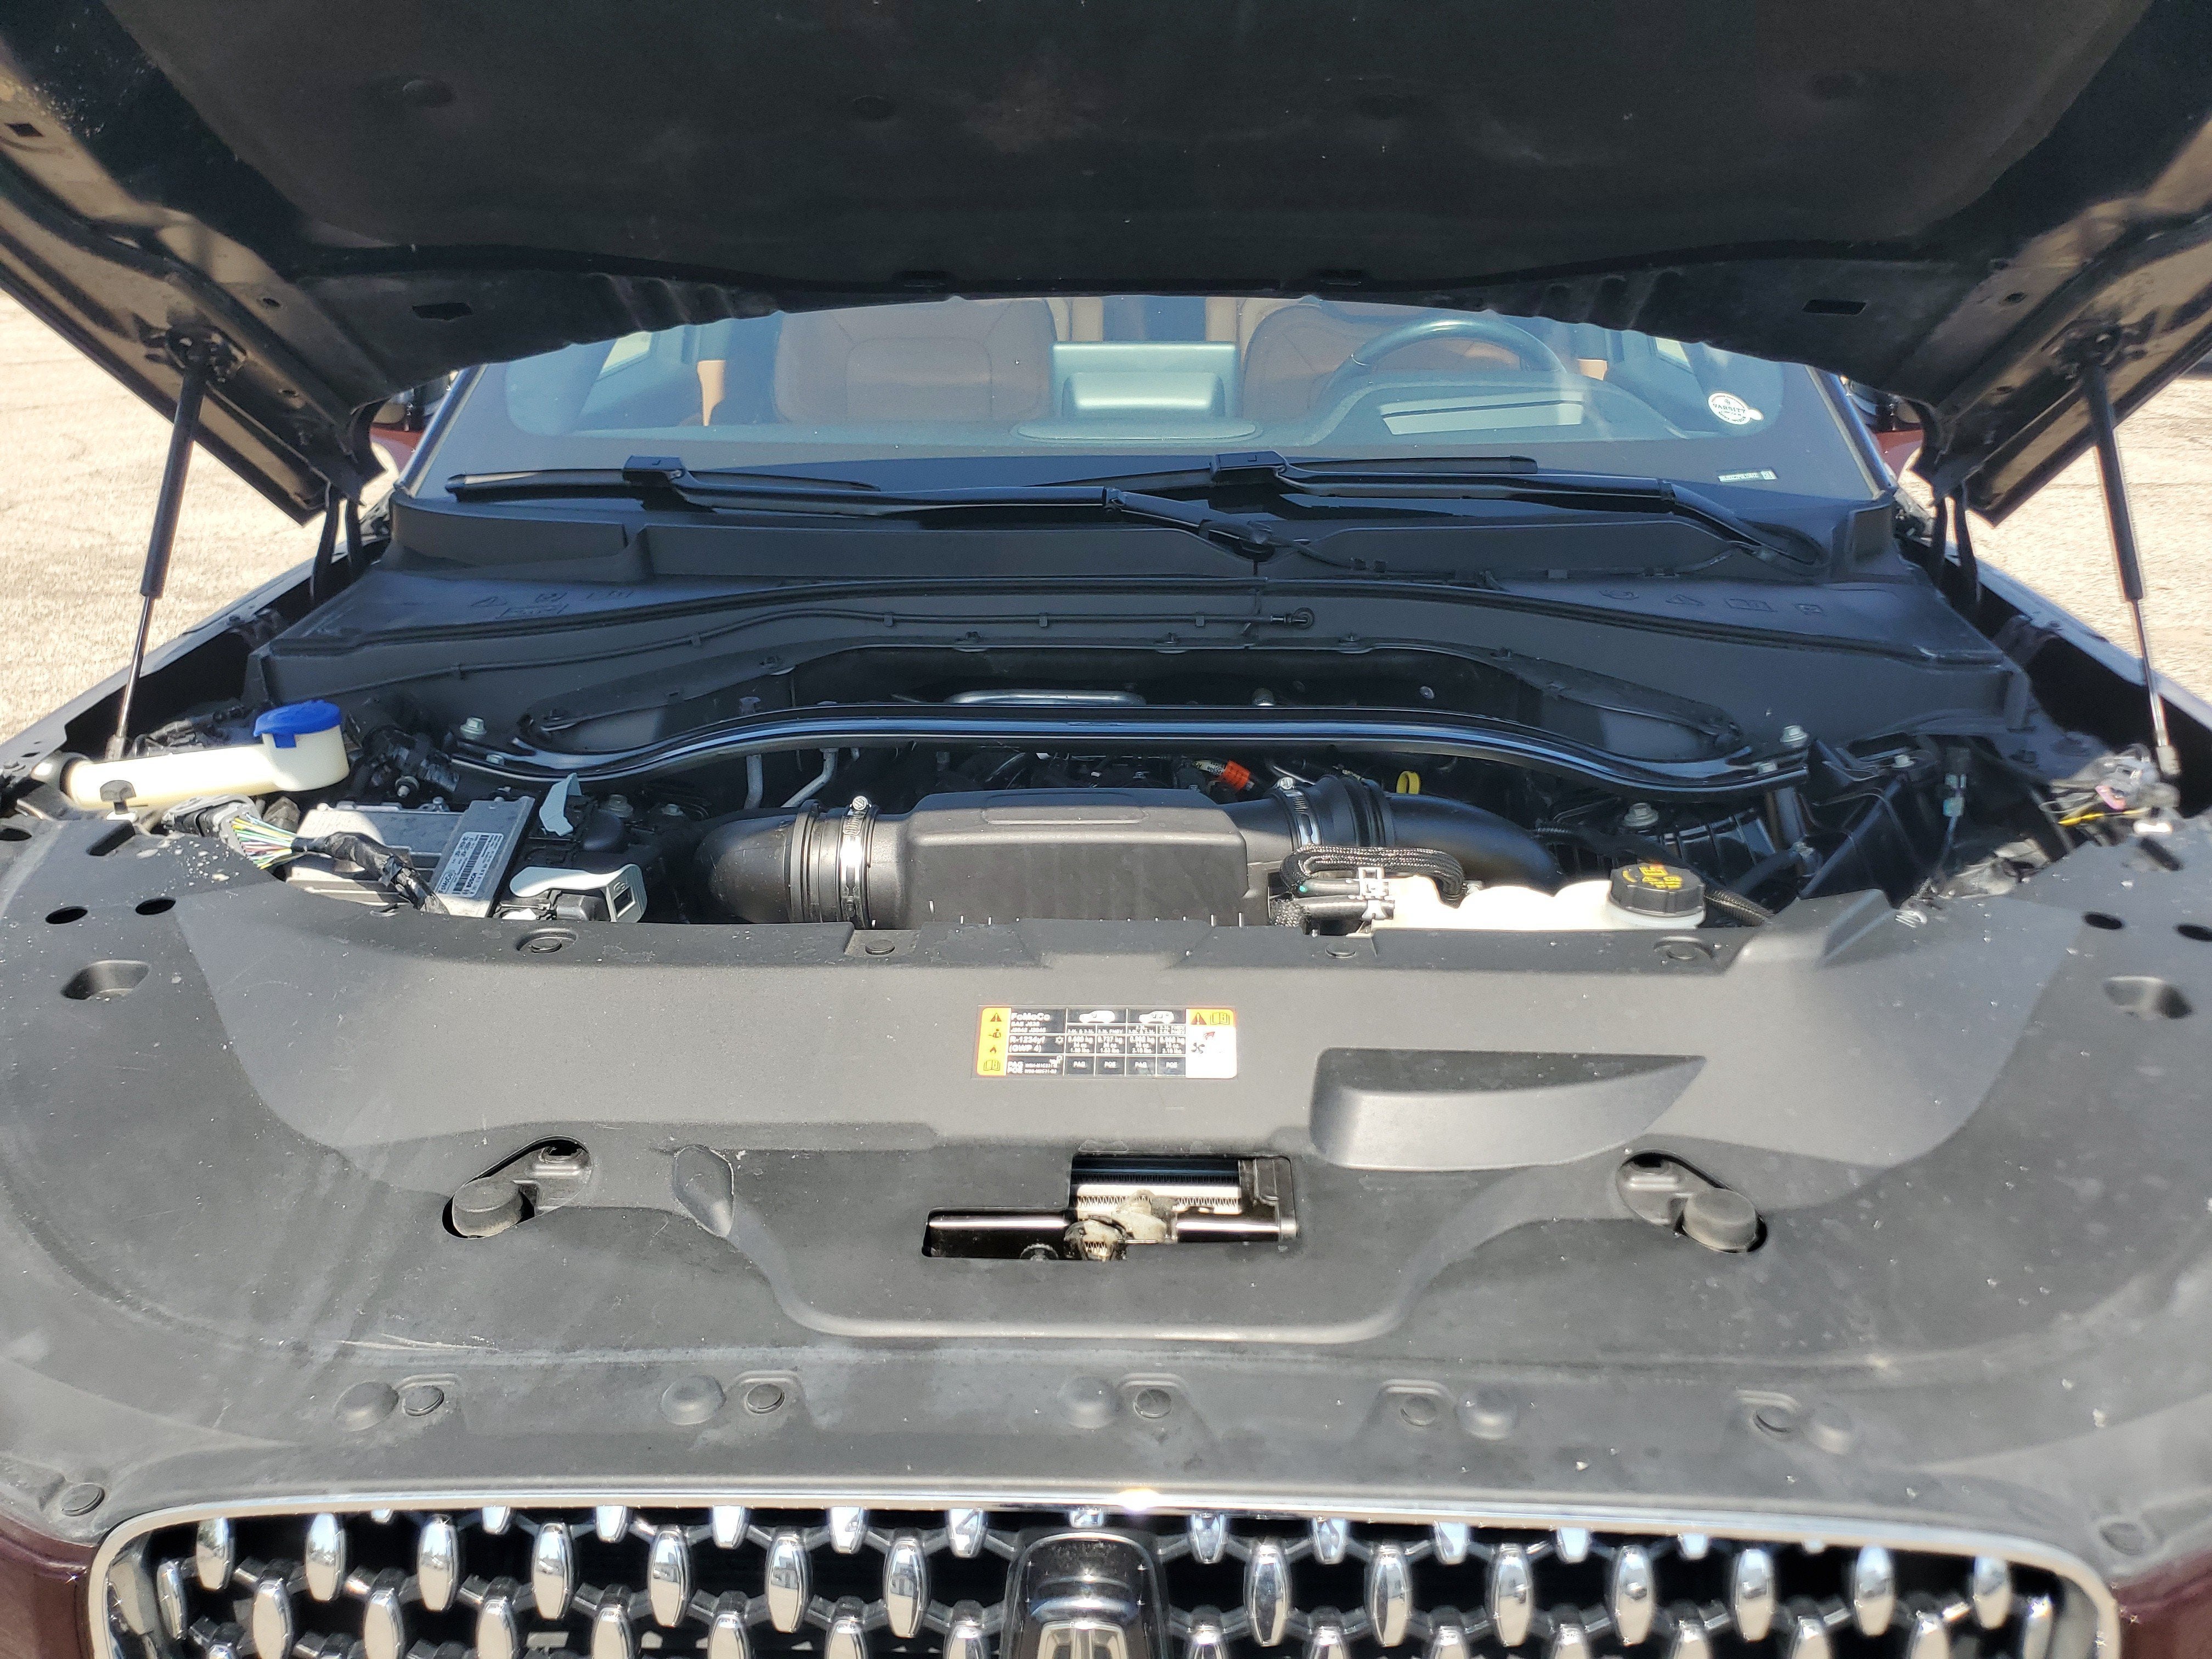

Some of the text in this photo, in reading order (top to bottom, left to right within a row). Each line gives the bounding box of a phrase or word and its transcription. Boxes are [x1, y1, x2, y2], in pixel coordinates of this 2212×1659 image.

[466, 872, 478, 888] BOSCH
[1011, 1012, 1051, 1021] FoMoCo
[1009, 1035, 1046, 1045] R-1234yf
